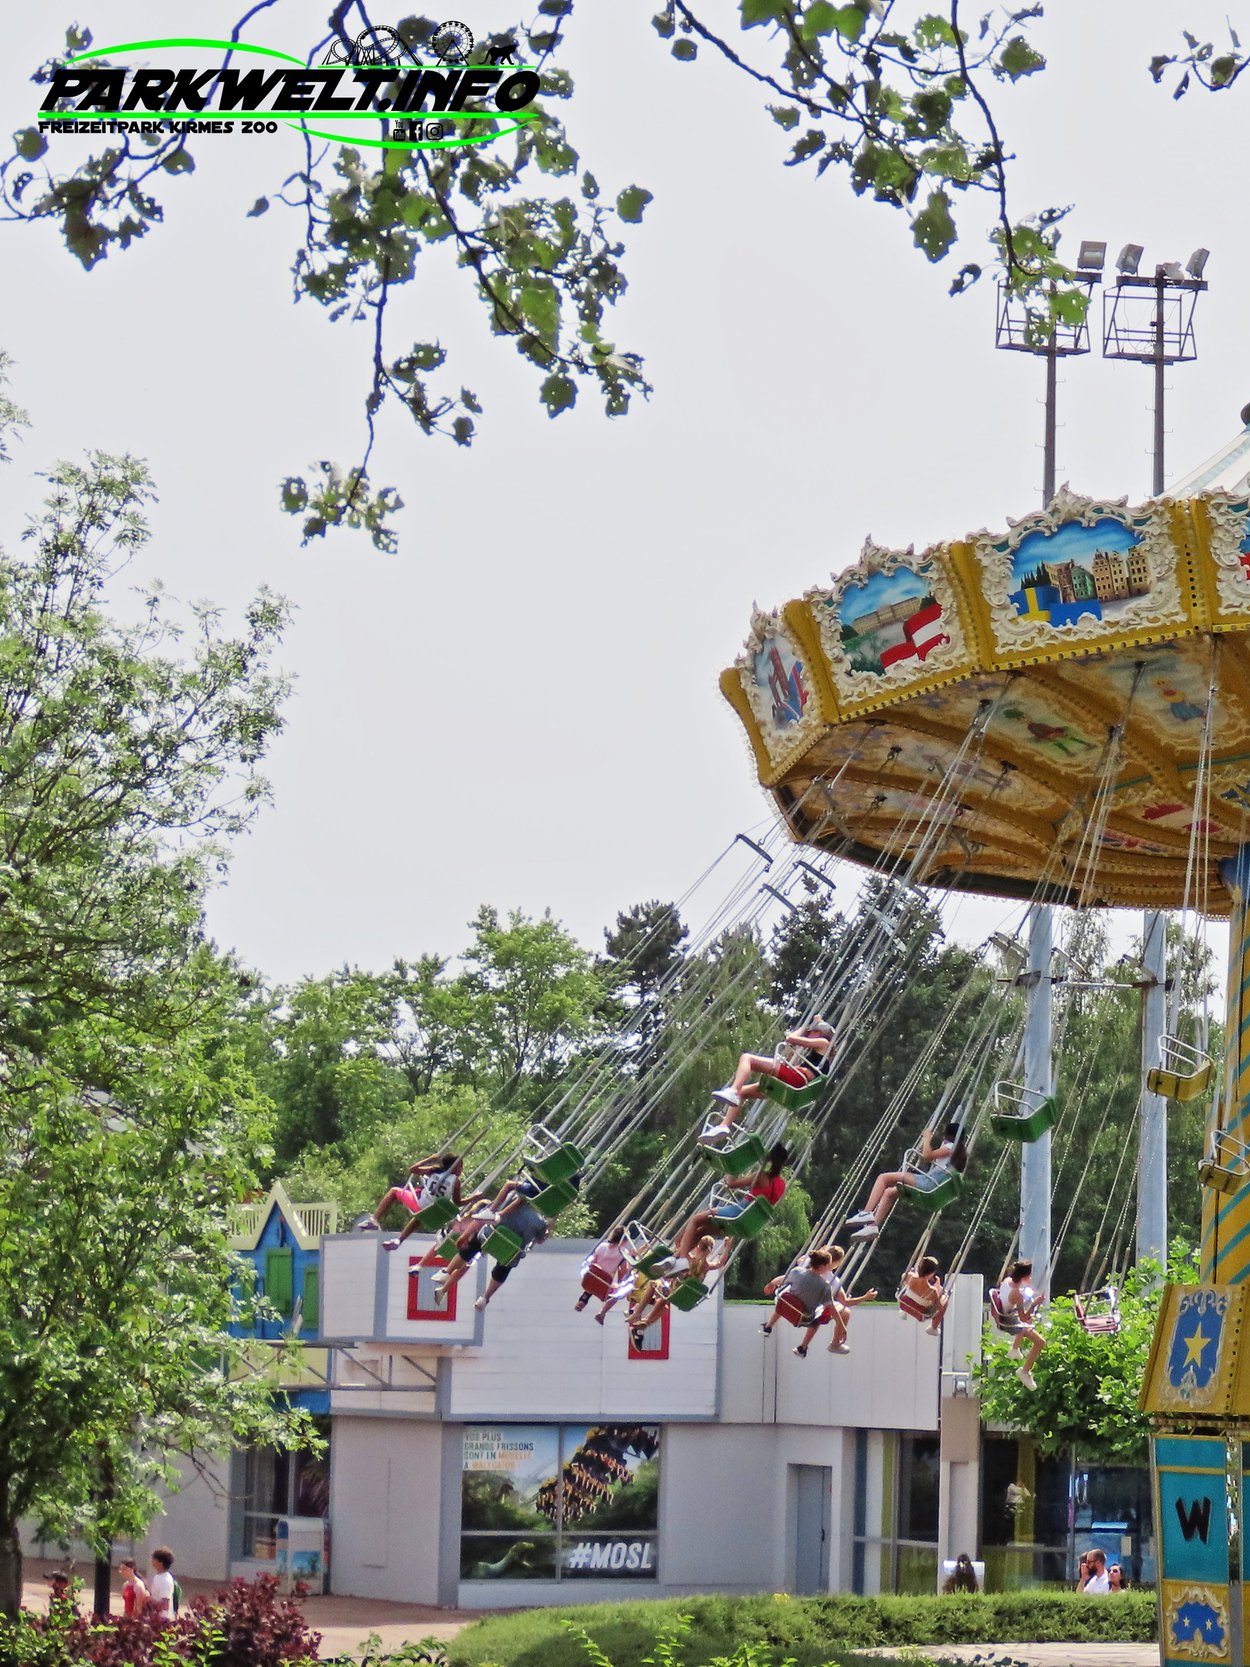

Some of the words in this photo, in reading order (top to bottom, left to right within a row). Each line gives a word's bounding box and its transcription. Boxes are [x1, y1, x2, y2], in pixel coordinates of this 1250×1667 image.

[482, 1432, 502, 1441] PLUS
[464, 1442, 494, 1451] GRANDS
[497, 1442, 534, 1451] FRISSONS
[464, 1451, 485, 1460] SONT
[1175, 1496, 1211, 1545] W
[568, 1542, 652, 1570] #MOSL
